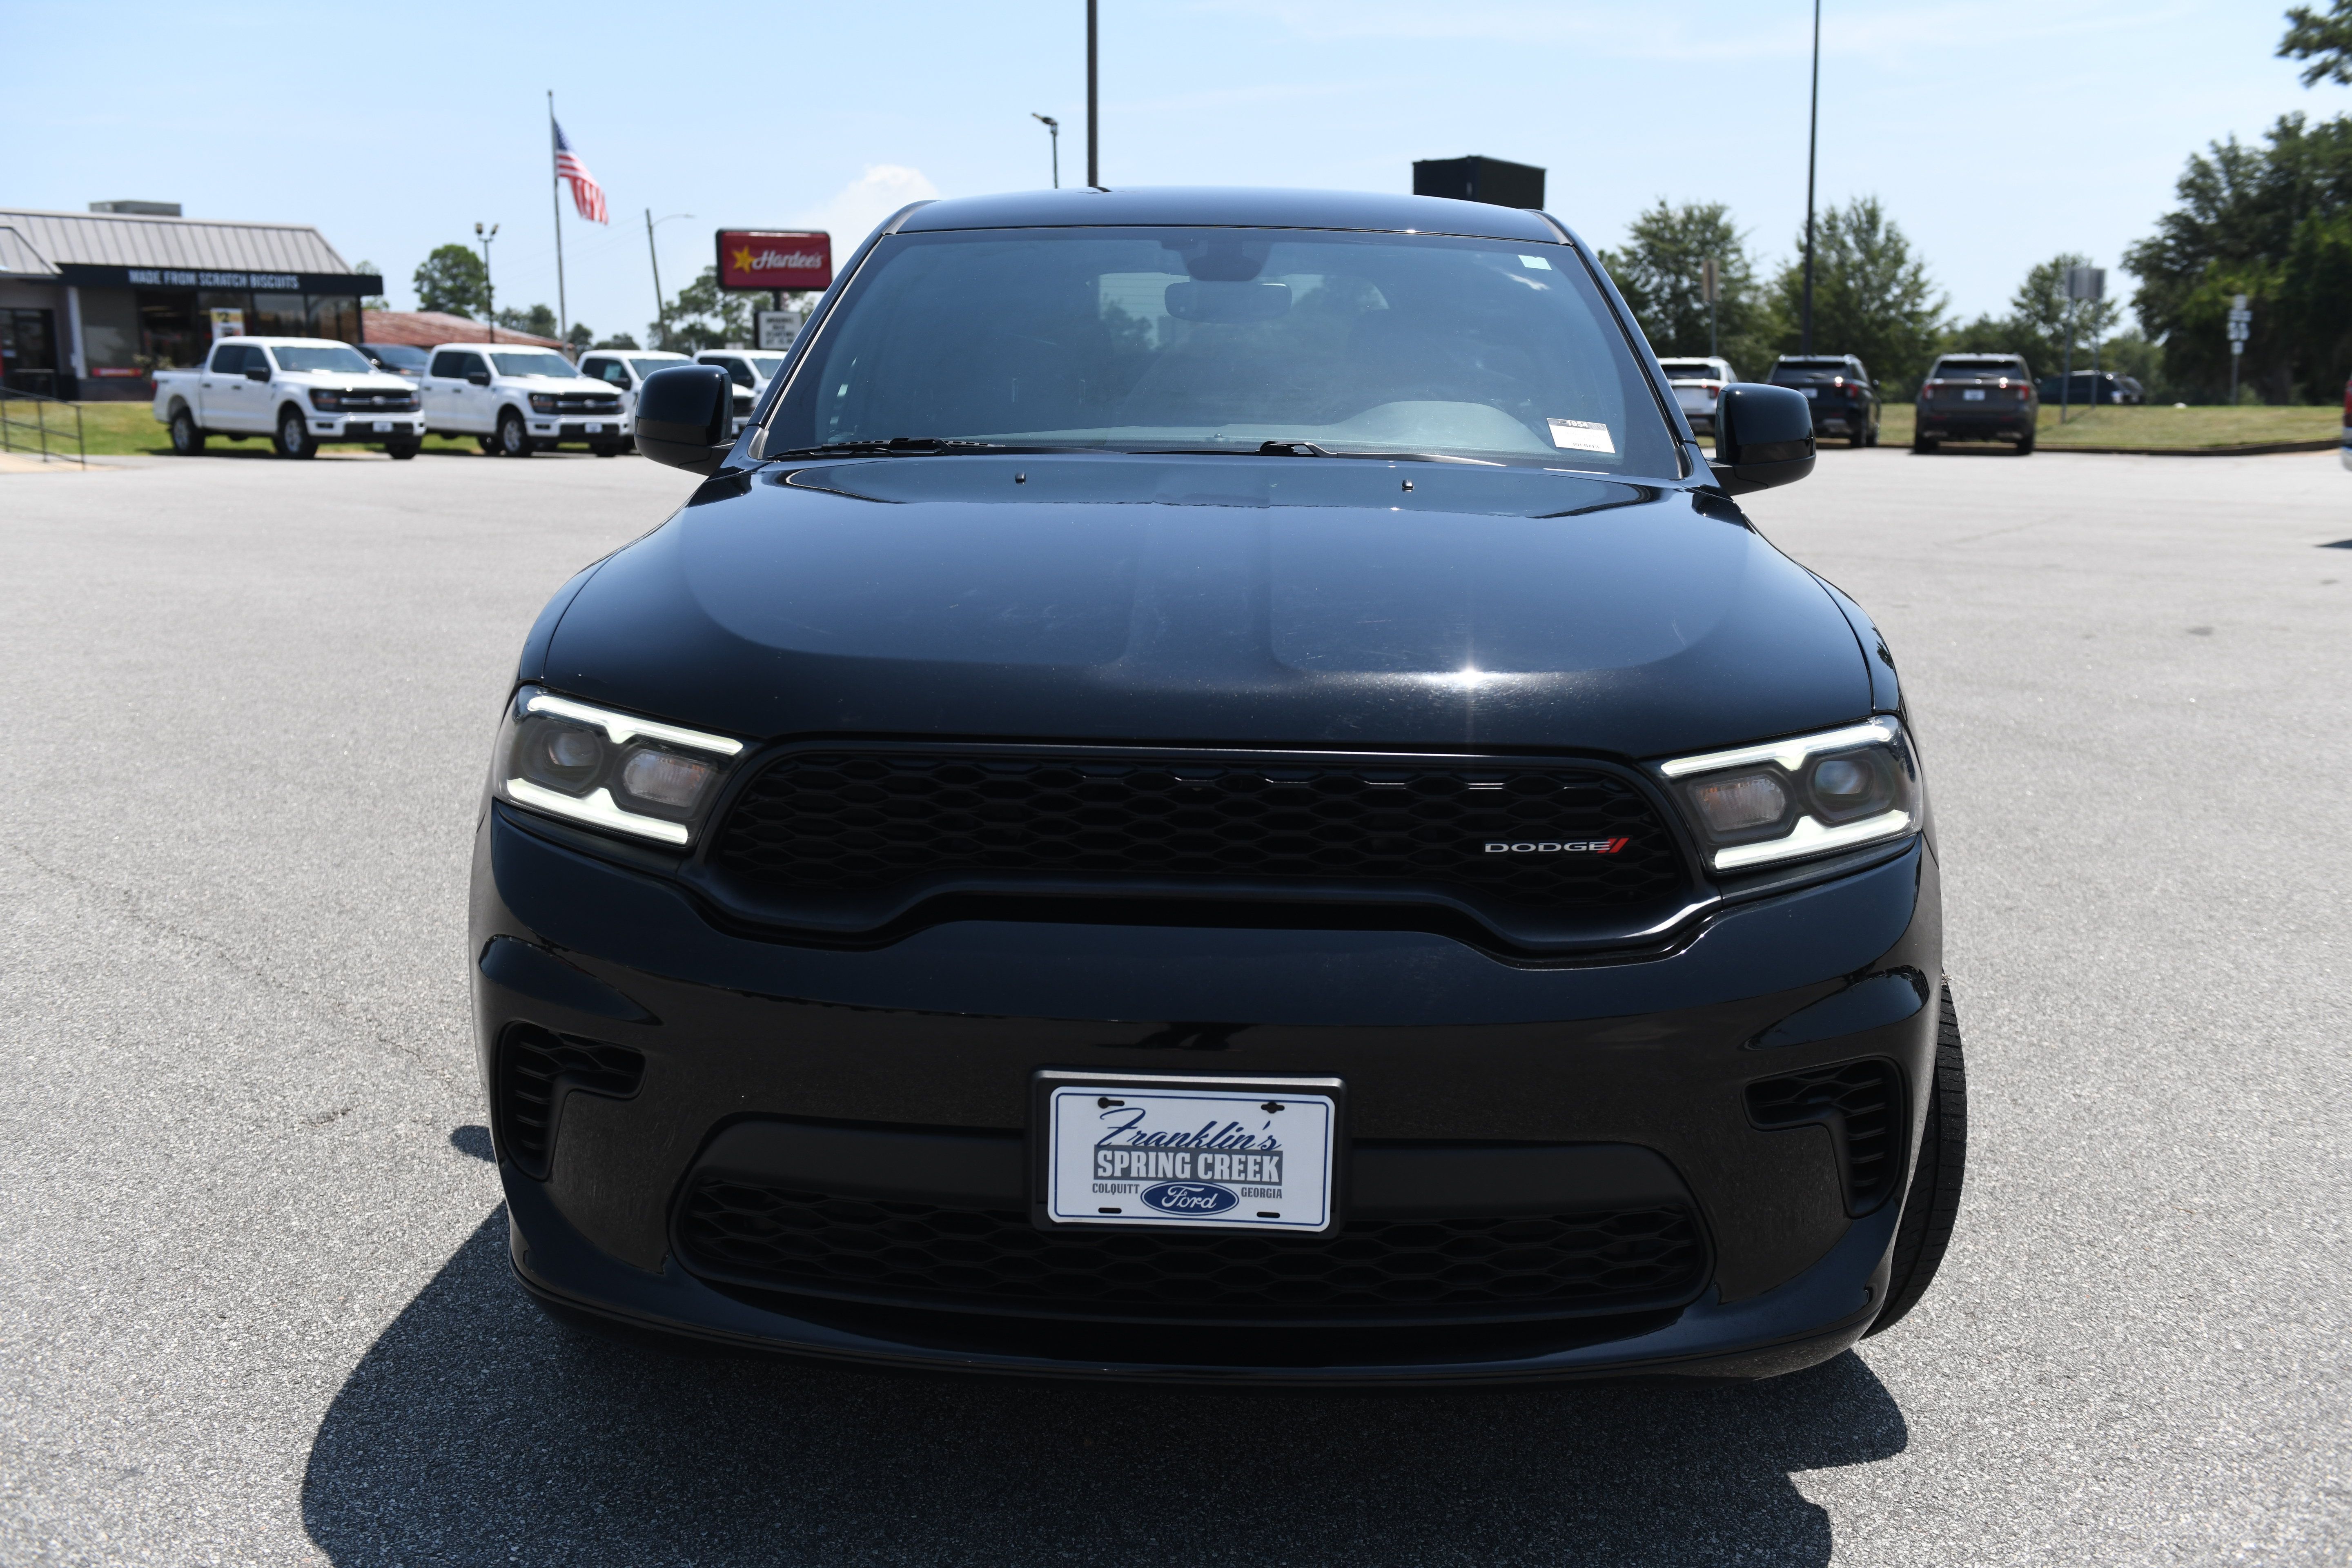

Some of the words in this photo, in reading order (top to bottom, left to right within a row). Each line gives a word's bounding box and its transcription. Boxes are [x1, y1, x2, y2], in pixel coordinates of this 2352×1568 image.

[752, 249, 822, 270] Hardee's
[129, 270, 161, 285] MADE
[164, 271, 197, 285] FROM
[198, 272, 247, 287] SCRATCH
[249, 273, 300, 289] BISCUITS
[1485, 841, 1611, 852] DODGE
[1096, 1107, 1282, 1151] Franklin's
[1097, 1150, 1192, 1179] SPRING
[1197, 1153, 1280, 1183] CREEK
[1092, 1183, 1140, 1195] COLQUITT
[1241, 1187, 1283, 1199] GEORGIA
[1161, 1185, 1218, 1209] Ford
